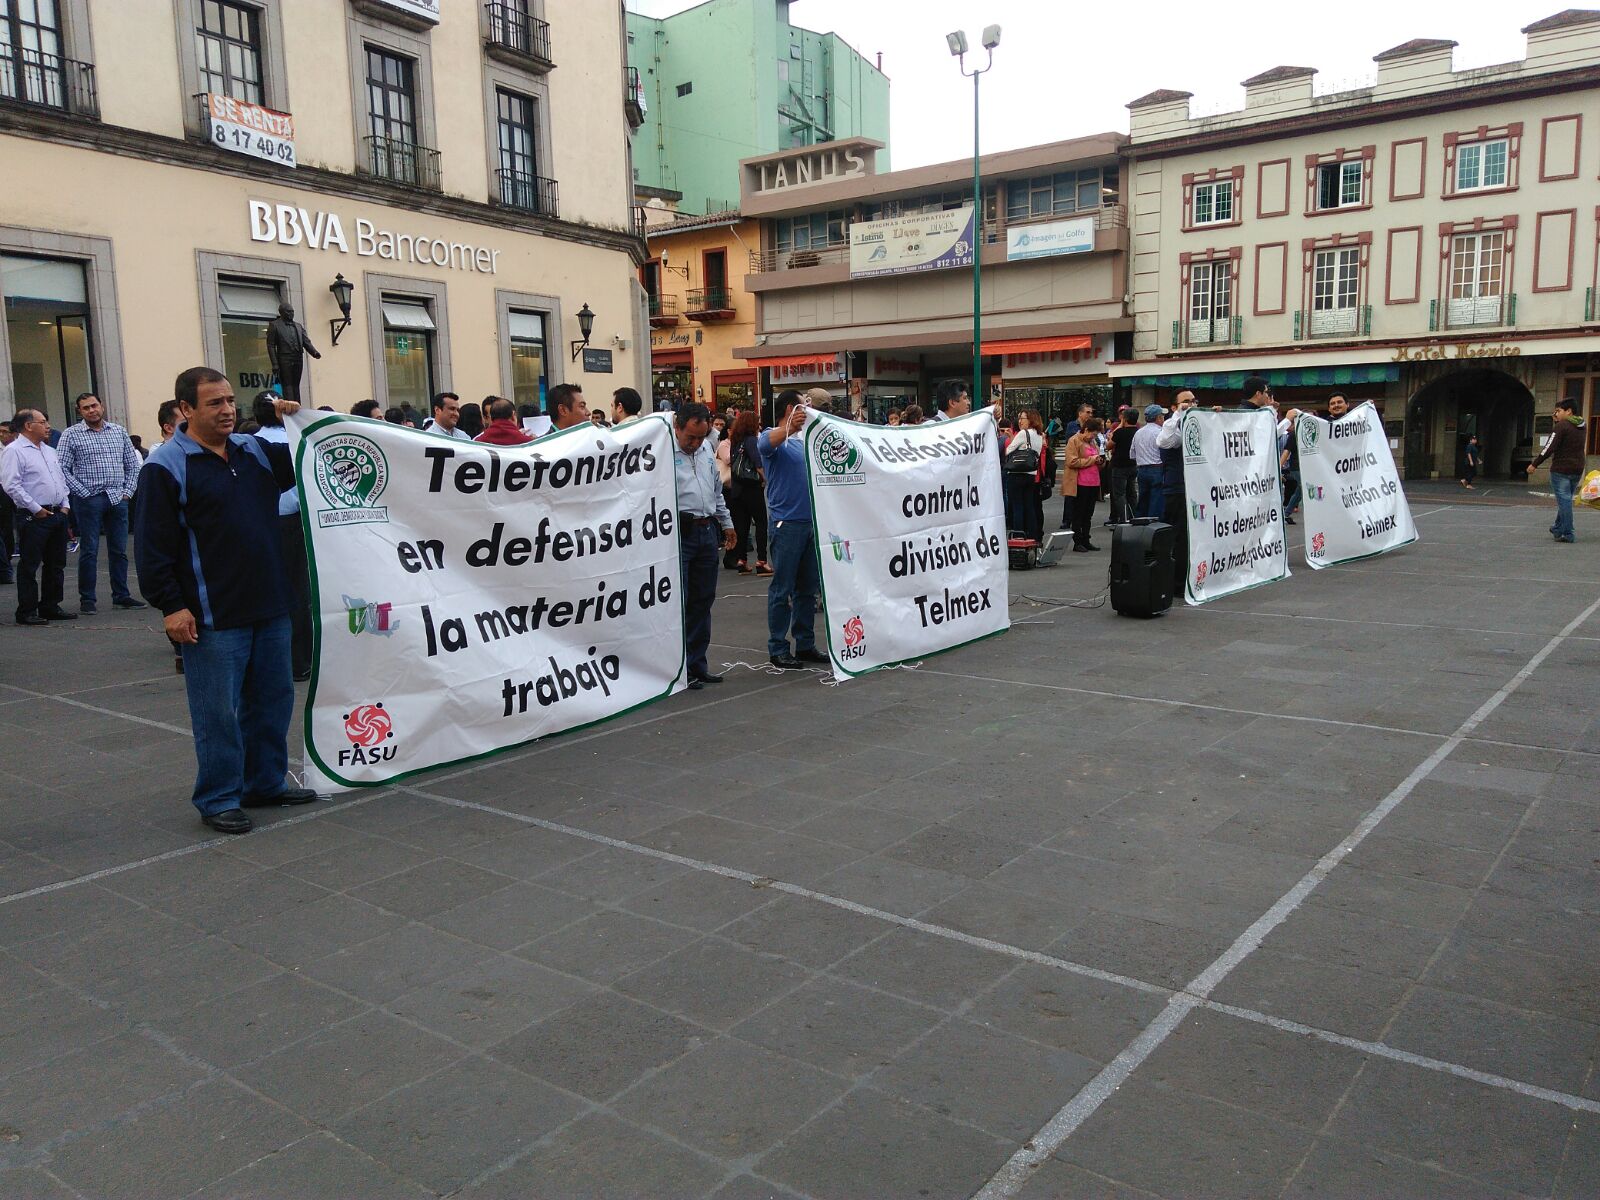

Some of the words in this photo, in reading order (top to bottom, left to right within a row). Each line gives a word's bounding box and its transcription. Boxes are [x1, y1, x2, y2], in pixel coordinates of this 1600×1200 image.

[213, 95, 238, 121] SE
[240, 105, 294, 138] RENTA
[215, 125, 226, 142] 8
[232, 129, 251, 149] 17
[257, 137, 274, 156] 40
[278, 143, 294, 162] 02
[249, 200, 349, 253] BBVA
[356, 218, 501, 274] Bancomer
[1066, 229, 1086, 238] Golfo
[936, 259, 950, 268] 812
[952, 258, 961, 266] 11
[1391, 345, 1447, 361] Hotel
[1455, 343, 1520, 359] México
[860, 431, 986, 464] Telefonistas
[1223, 430, 1256, 458] IFETEL
[1363, 451, 1378, 467] la
[424, 440, 656, 494] Telefonistas
[902, 484, 963, 518] contra
[967, 475, 980, 508] la
[1210, 478, 1241, 508] quiere
[1380, 475, 1397, 496] de
[397, 537, 445, 573] en
[464, 517, 633, 568] defensa
[641, 497, 673, 541] de
[1213, 514, 1229, 538] los
[1357, 514, 1397, 539] Telmex
[889, 533, 971, 578] división
[975, 526, 1000, 559] de
[1209, 552, 1226, 575] los
[421, 605, 468, 657] la
[475, 580, 627, 645] materia
[638, 566, 672, 608] de
[914, 588, 992, 628] Telmex
[841, 645, 866, 661] FASU
[501, 646, 621, 717] trabajo
[339, 745, 398, 766] FASU
